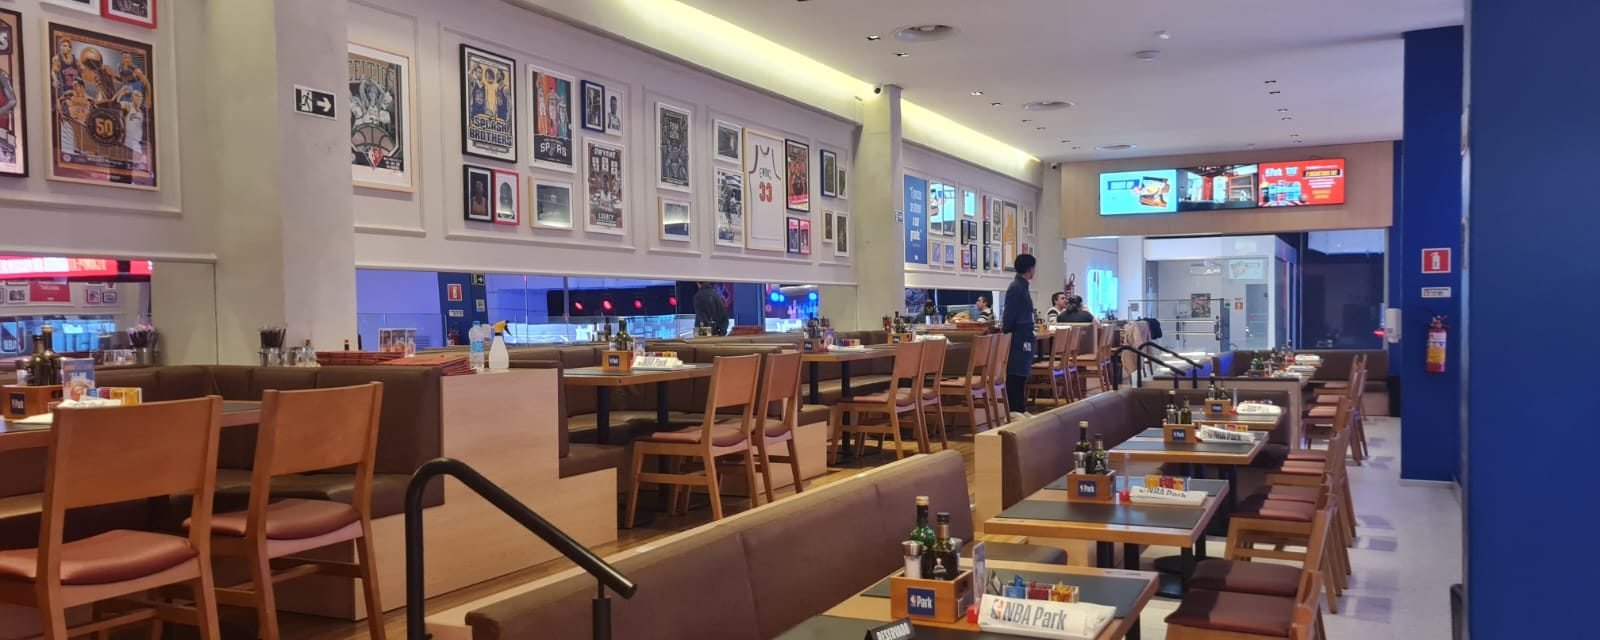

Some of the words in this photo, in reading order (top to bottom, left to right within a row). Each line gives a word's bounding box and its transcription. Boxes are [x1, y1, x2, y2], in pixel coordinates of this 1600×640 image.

[95, 118, 114, 137] 50
[473, 115, 508, 132] SPLASH
[469, 127, 513, 147] BROTHERS
[759, 181, 773, 202] 33
[916, 595, 933, 608] Park
[1004, 602, 1032, 625] NBA
[1032, 606, 1067, 631] Park
[876, 622, 911, 640] RESERVADO
